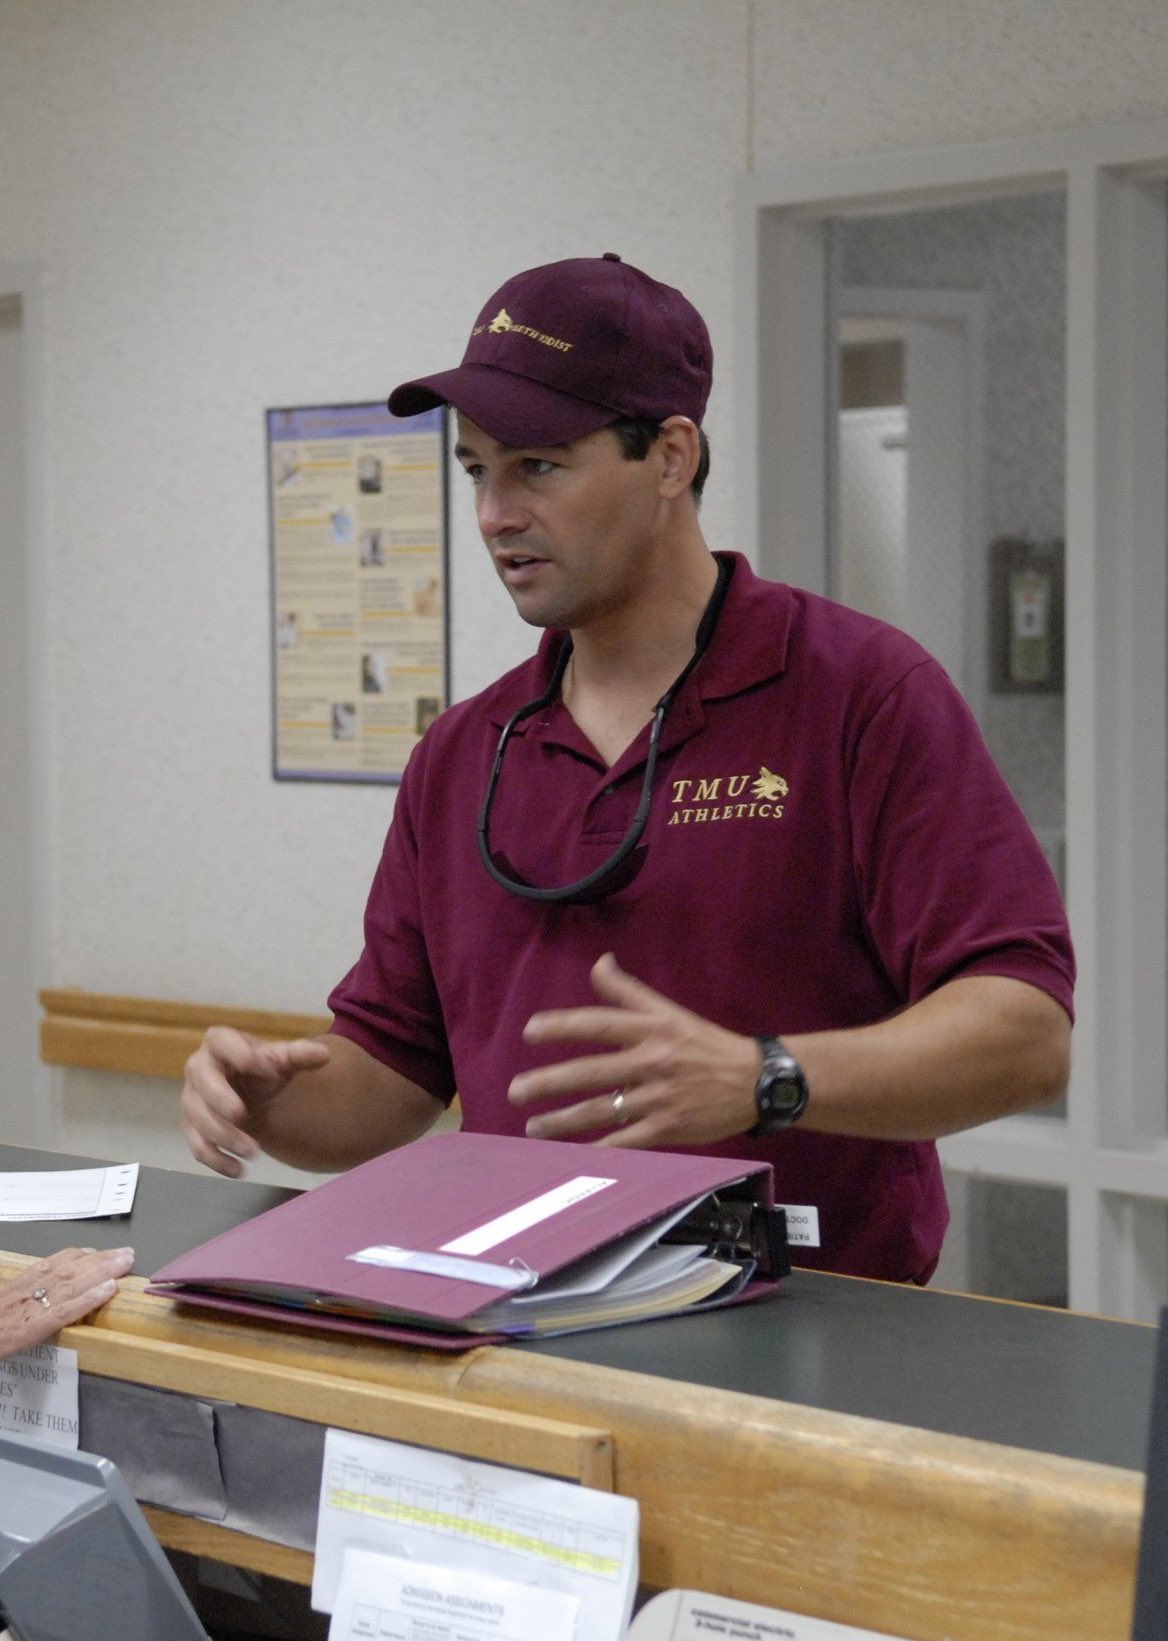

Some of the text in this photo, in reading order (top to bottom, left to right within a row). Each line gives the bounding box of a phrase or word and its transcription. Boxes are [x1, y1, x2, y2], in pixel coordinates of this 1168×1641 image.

[672, 775, 750, 802] TMU
[667, 803, 784, 825] ATHLETICS
[20, 1364, 59, 1385] UNDER
[13, 1406, 42, 1426] TAKE
[45, 1413, 78, 1435] THEM
